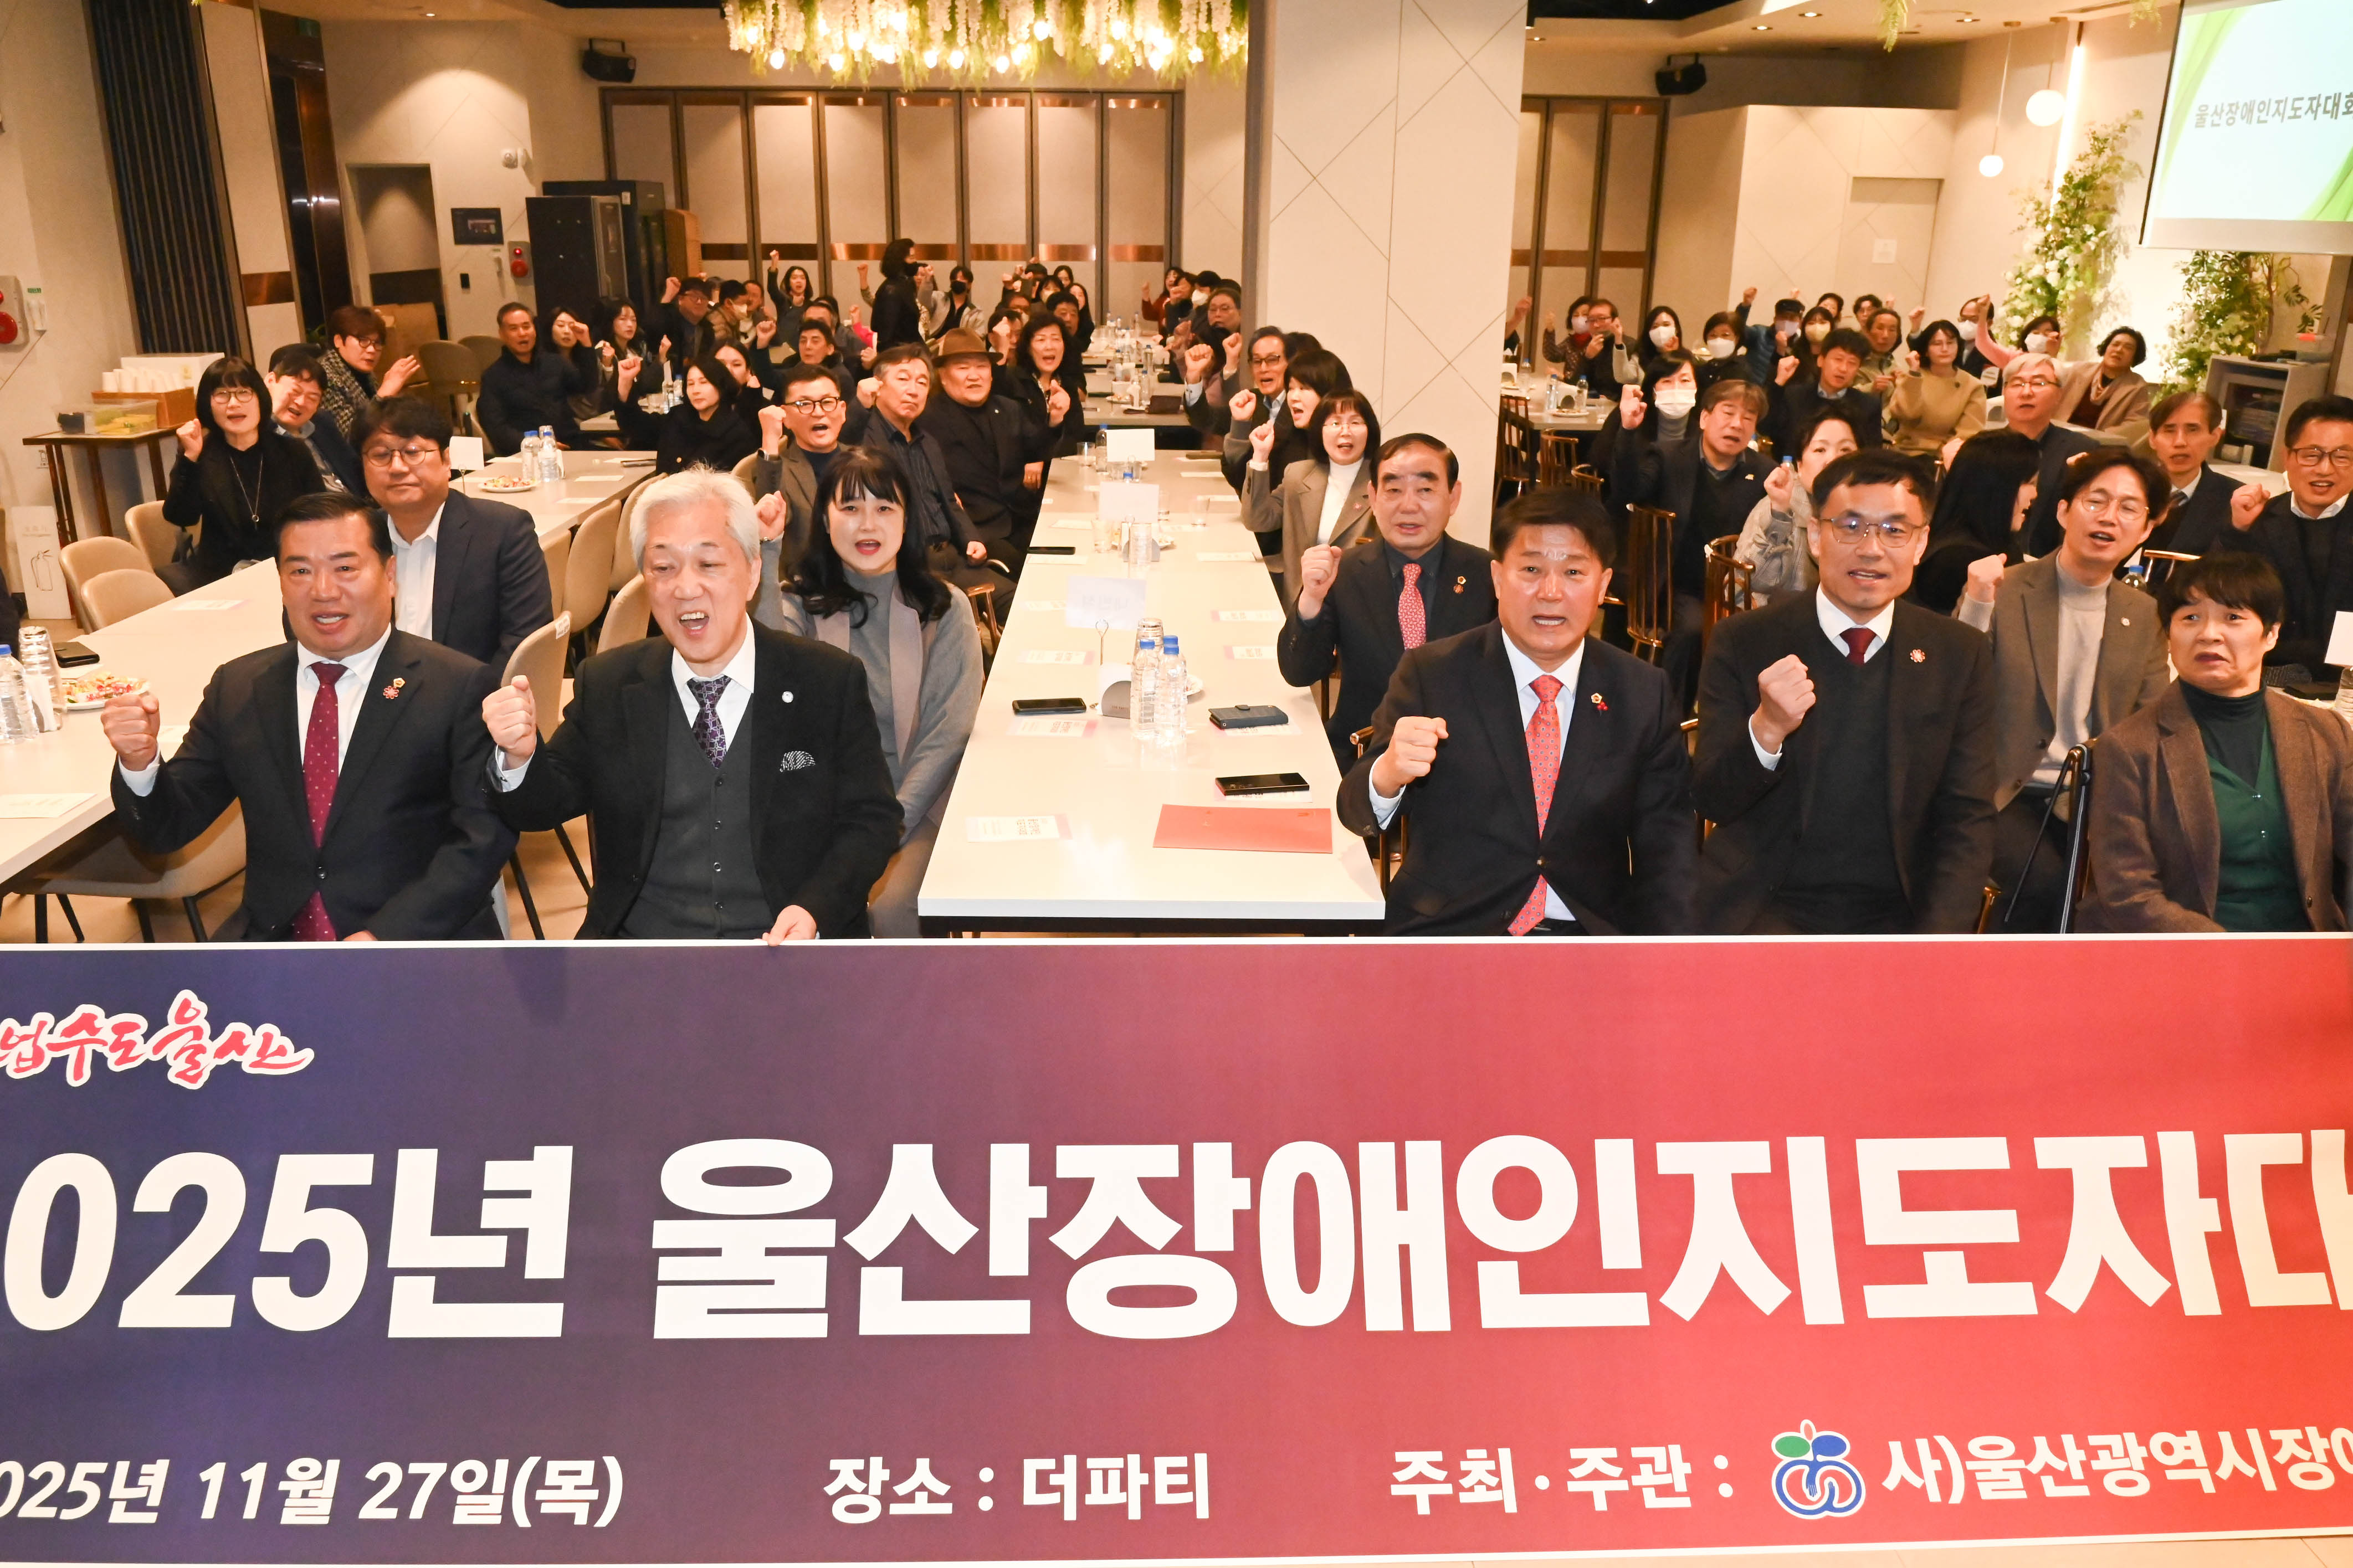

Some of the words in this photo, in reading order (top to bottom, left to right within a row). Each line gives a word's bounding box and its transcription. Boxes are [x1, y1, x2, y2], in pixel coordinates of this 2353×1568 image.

[652, 1129, 2353, 1339] 울산장애인지도자대
[199, 1457, 340, 1524] 11월
[358, 1456, 623, 1528] 27일(목)
[824, 1456, 953, 1524] 장소
[1023, 1453, 1209, 1521] 더파티
